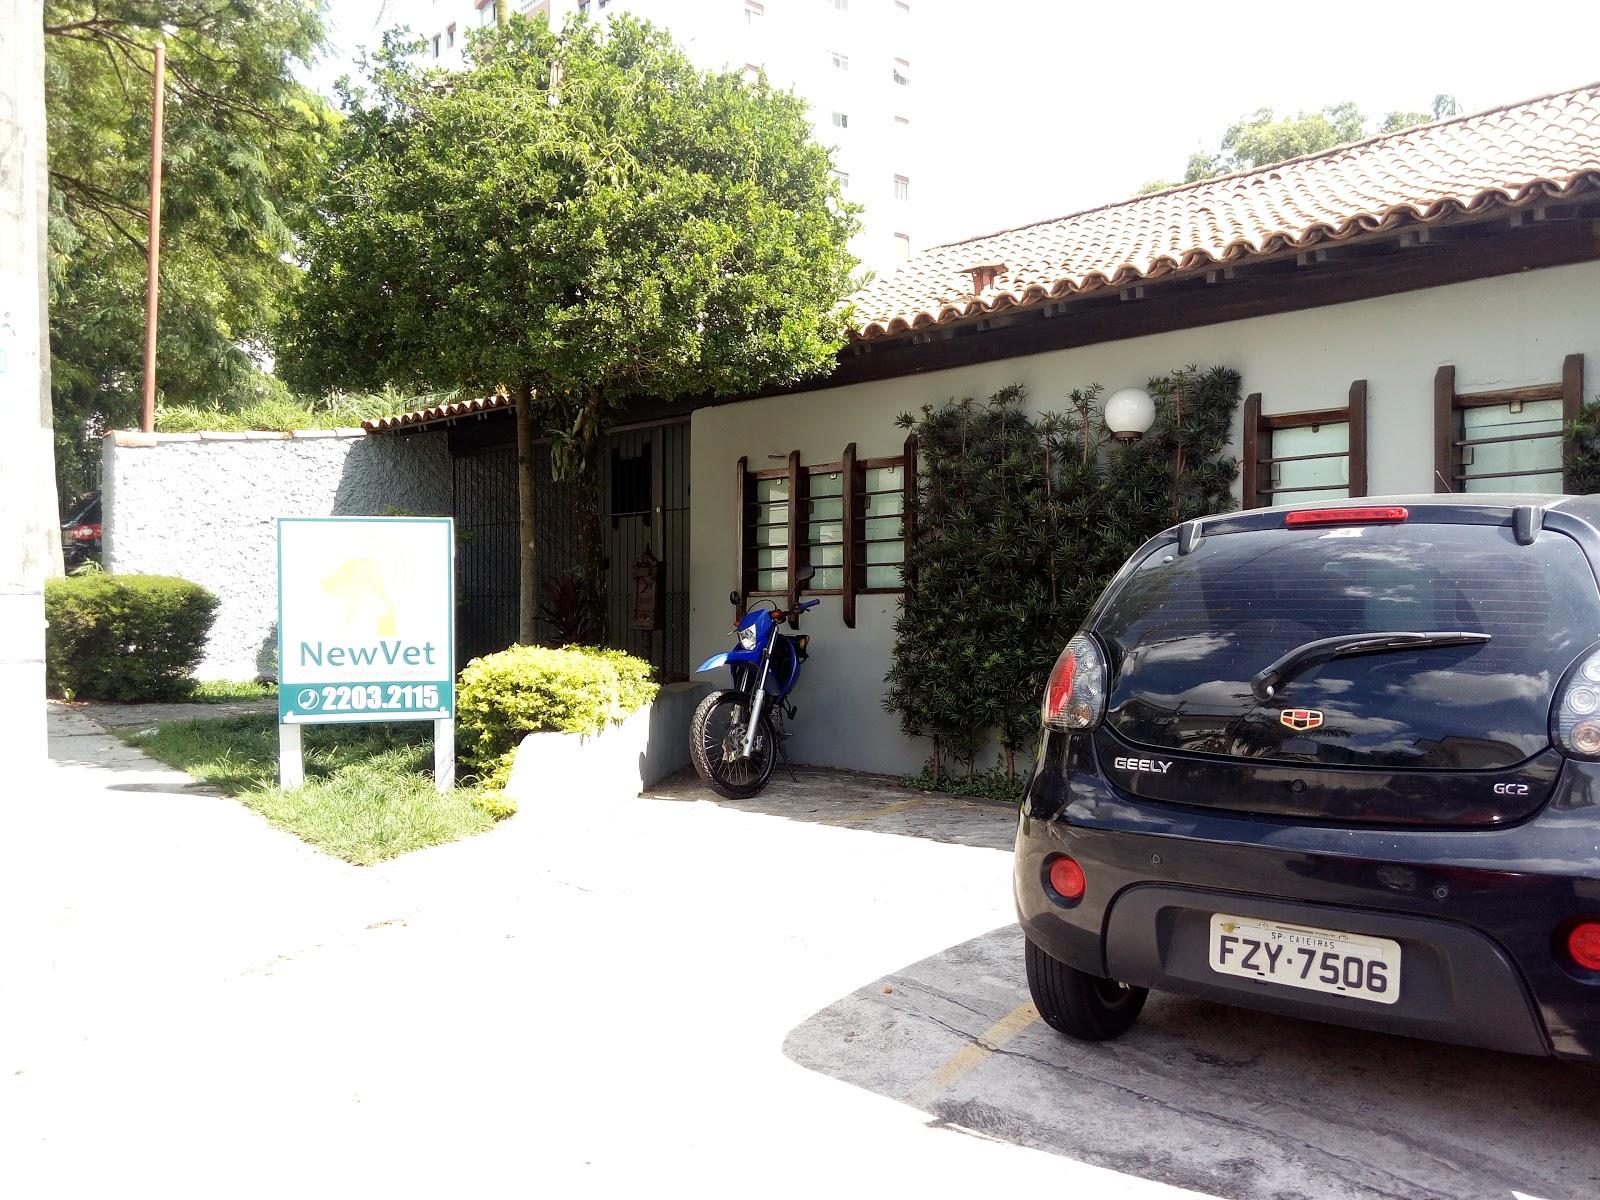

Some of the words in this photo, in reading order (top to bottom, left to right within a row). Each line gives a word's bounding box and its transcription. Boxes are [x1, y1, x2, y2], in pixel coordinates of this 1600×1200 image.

[300, 640, 436, 667] NewVet
[321, 685, 439, 711] 2203.2115
[1114, 756, 1173, 774] GEELY
[1493, 781, 1529, 796] GC2
